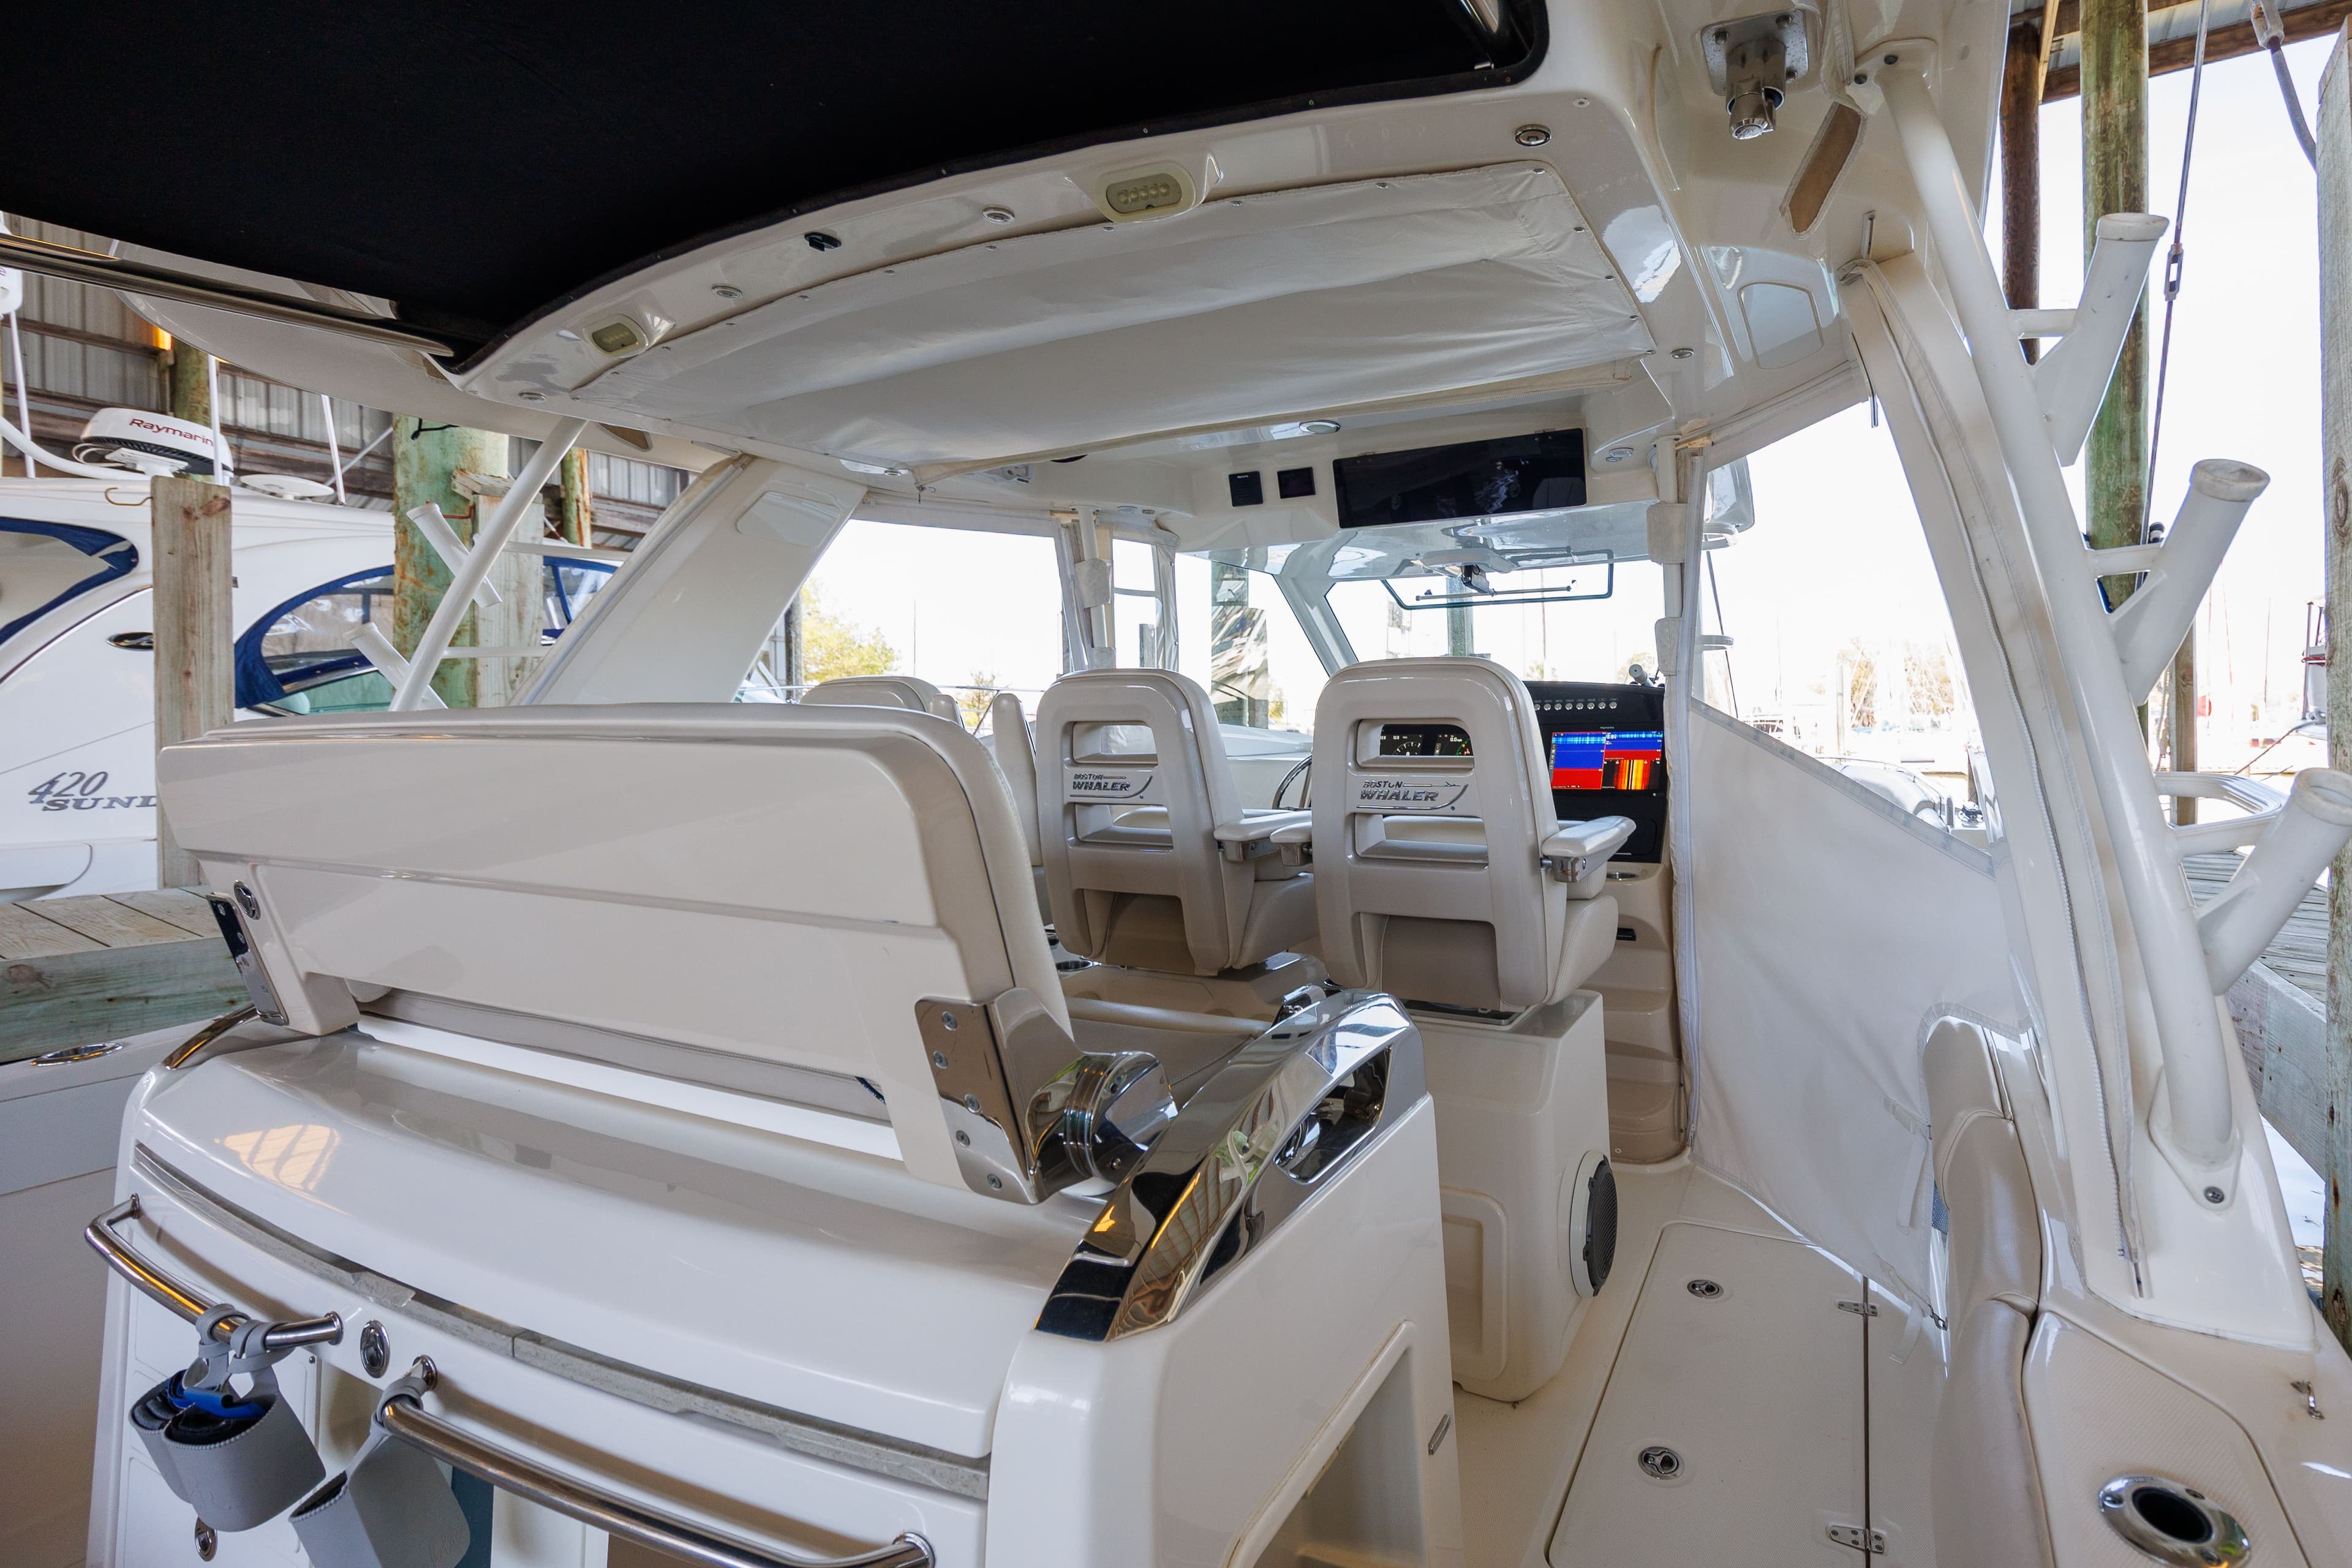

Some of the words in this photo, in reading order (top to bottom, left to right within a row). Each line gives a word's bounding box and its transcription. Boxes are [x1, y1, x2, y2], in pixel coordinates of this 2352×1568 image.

[28, 771, 108, 804] 420
[1072, 781, 1131, 791] WHALER
[1363, 780, 1403, 789] BOSTON
[1360, 789, 1439, 801] WHALER
